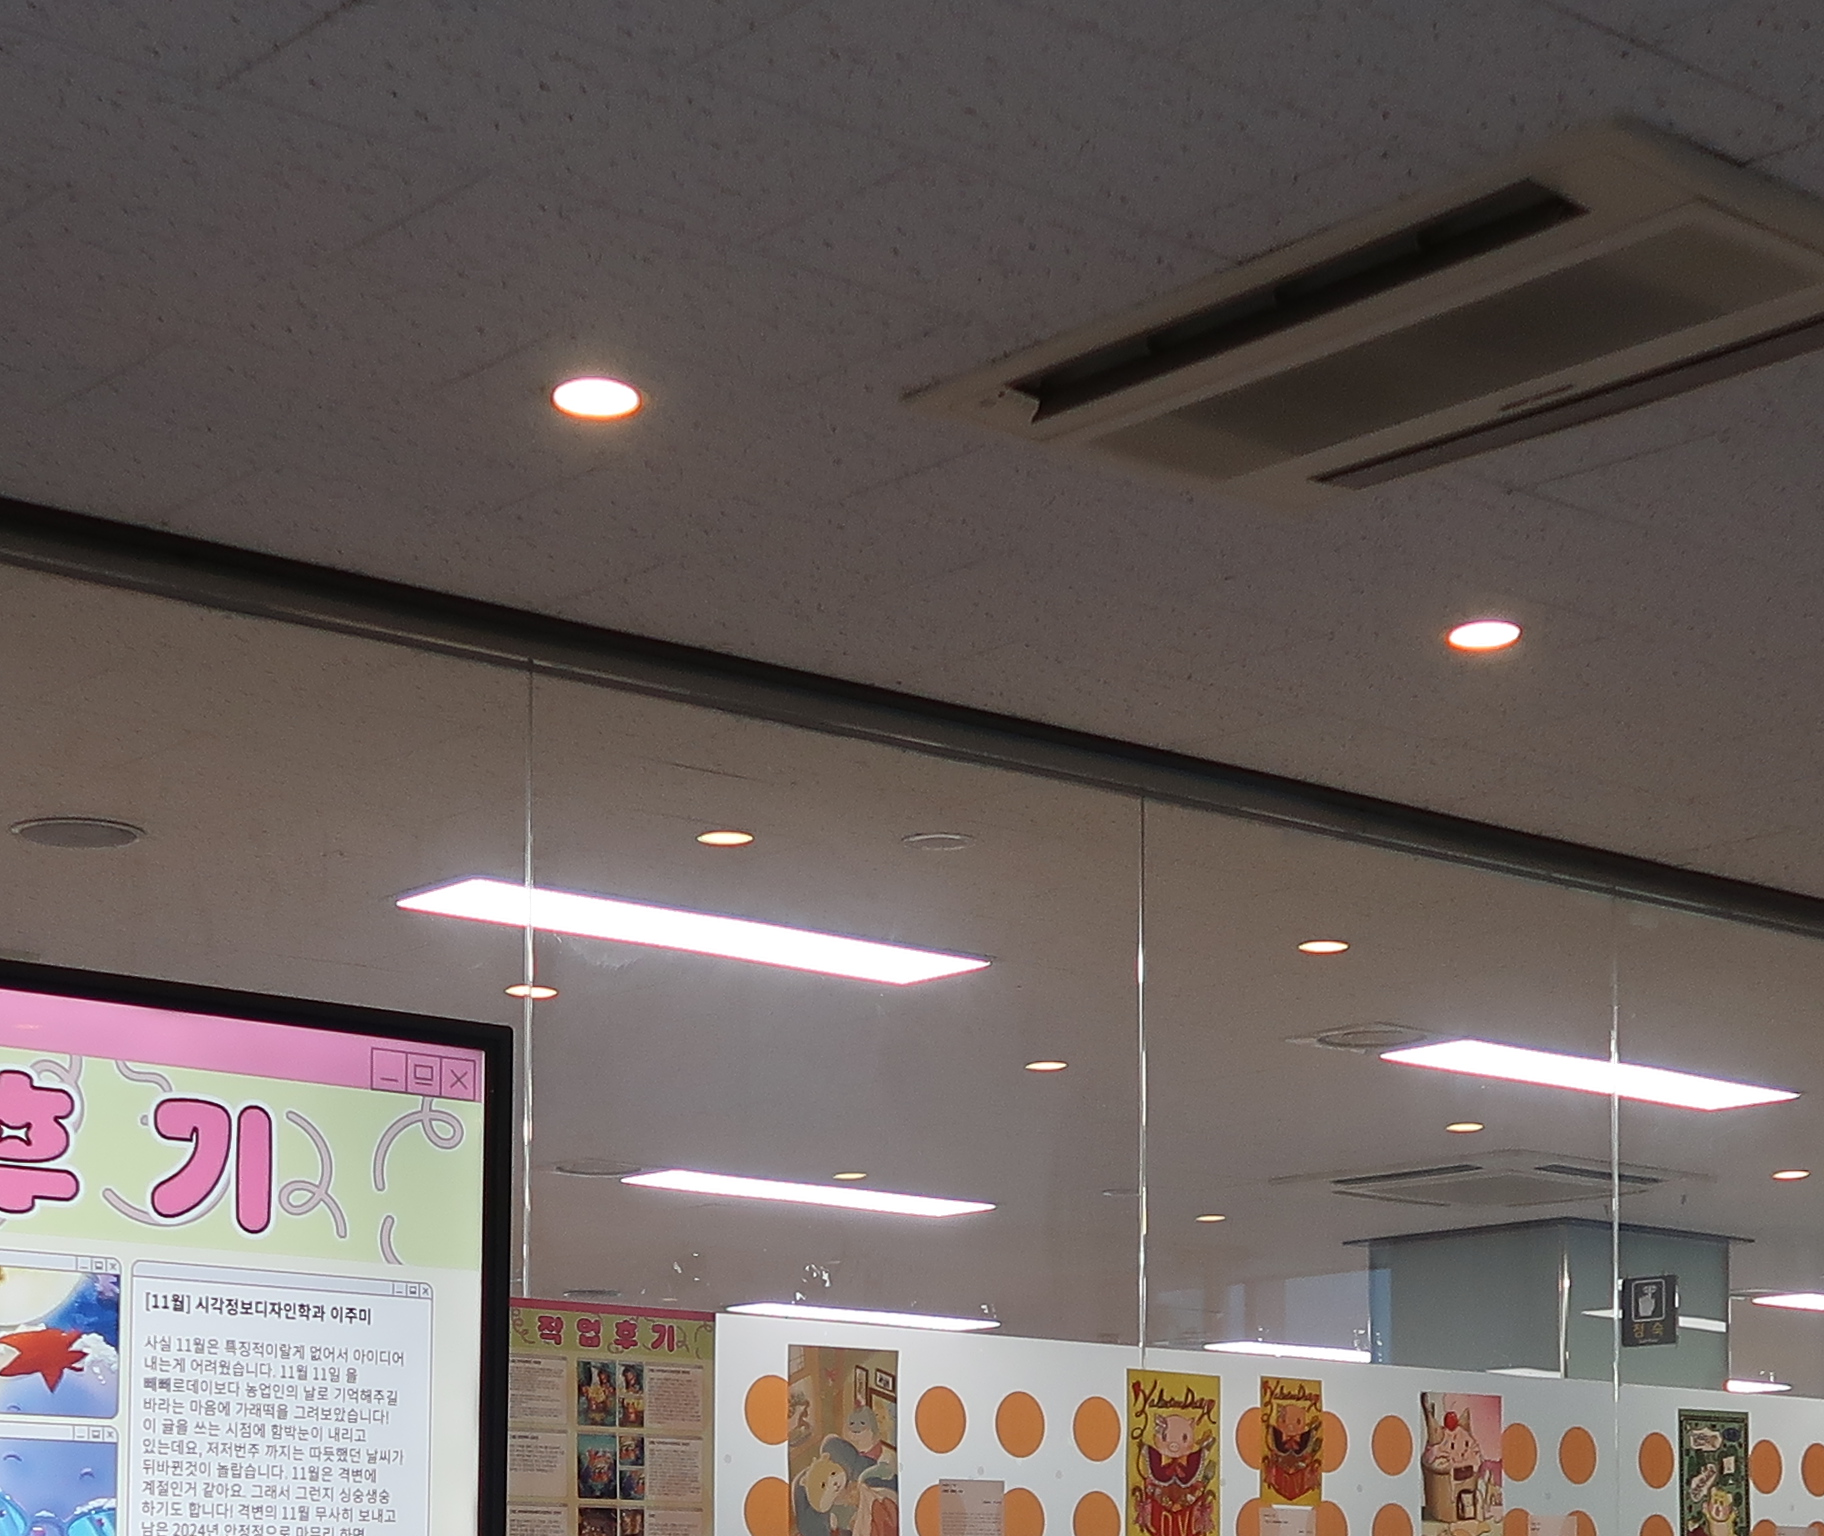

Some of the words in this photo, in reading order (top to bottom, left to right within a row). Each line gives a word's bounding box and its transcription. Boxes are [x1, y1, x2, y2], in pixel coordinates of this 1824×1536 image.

[144, 1291, 191, 1314] [11월]
[194, 1294, 327, 1323] 시각정보디자인학과
[329, 1304, 371, 1326] 이주미
[143, 1333, 171, 1352] 사실
[176, 1335, 220, 1355] 11월은
[309, 1344, 348, 1364] 없어서
[350, 1347, 404, 1368] 아이디어
[143, 1354, 186, 1374] 내는게
[279, 1362, 308, 1381] 11월
[312, 1364, 343, 1383] 11일
[142, 1375, 240, 1399] 빼빼로데이보다
[242, 1380, 298, 1400] 농업인의
[300, 1384, 329, 1404] 날로
[142, 1396, 185, 1415] 바라는
[189, 1398, 231, 1417] 마음에
[160, 1417, 188, 1435] 글을
[193, 1419, 221, 1437] 쓰는
[224, 1420, 266, 1440] 시점에
[327, 1424, 366, 1444] 내리고
[142, 1437, 202, 1458] 있는데요,
[261, 1442, 305, 1461] 까지는
[365, 1447, 404, 1465] 날씨가
[291, 1464, 333, 1482] 11월은
[337, 1466, 376, 1485] 격변에
[141, 1478, 197, 1498] 계절인거
[250, 1482, 290, 1500] 그래서
[294, 1484, 334, 1504] 그런지
[140, 1499, 183, 1517] 하기도
[188, 1500, 233, 1519] 합니다!
[237, 1502, 277, 1521] 격변의
[279, 1504, 310, 1521] 11월
[312, 1504, 353, 1524] 무사히
[354, 1505, 396, 1525] 보내고
